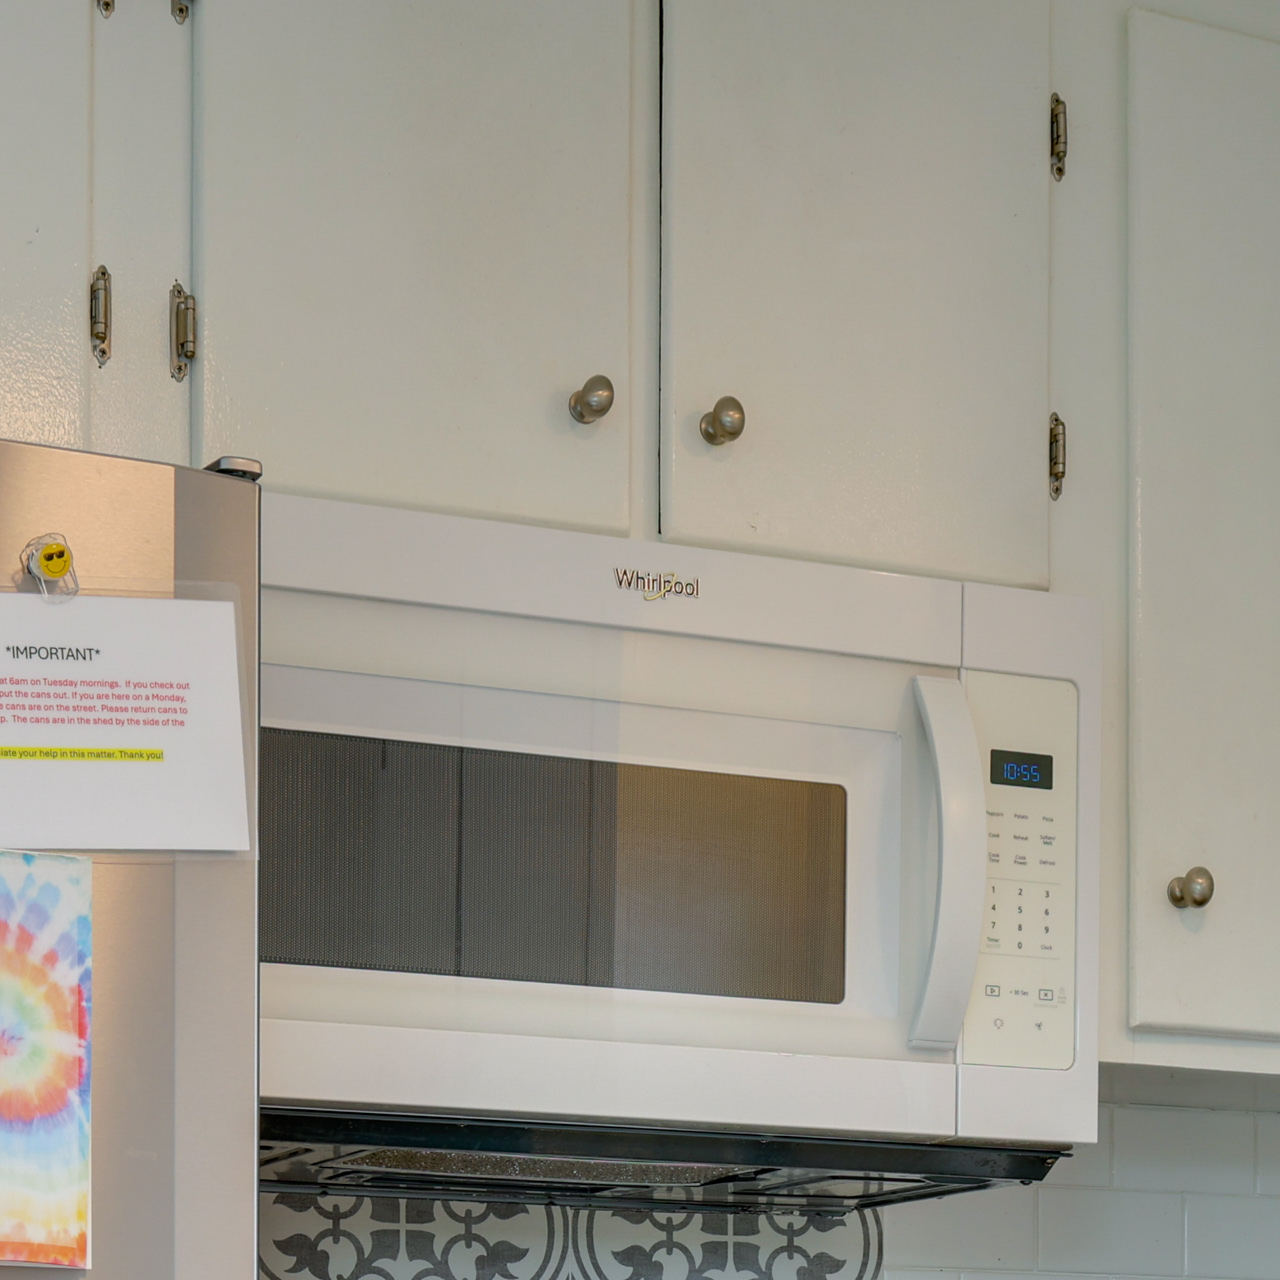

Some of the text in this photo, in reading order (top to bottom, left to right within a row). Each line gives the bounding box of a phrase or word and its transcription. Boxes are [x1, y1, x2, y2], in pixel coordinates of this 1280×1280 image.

[614, 568, 700, 599] Whirlpool
[9, 677, 28, 685] 6am
[42, 678, 78, 688] Tuesday
[80, 680, 122, 690] mornings.
[132, 682, 148, 690] you
[150, 681, 175, 689] check
[14, 690, 29, 698] the
[79, 693, 94, 701] you
[112, 693, 130, 701] here
[152, 693, 186, 704] Monday,
[56, 704, 70, 712] the
[101, 704, 129, 713] Please
[12, 715, 28, 723] The
[68, 716, 75, 724] in
[77, 717, 91, 725] the
[93, 717, 114, 725] shed
[115, 718, 125, 727] by
[126, 718, 140, 726] the
[142, 718, 160, 726] side
[171, 719, 185, 727] the
[18, 751, 38, 759] your
[39, 750, 58, 759] help
[60, 749, 68, 758] in
[70, 750, 86, 758] this
[118, 750, 144, 759] Thank
[146, 752, 164, 761] you!
[1003, 763, 1040, 782] 10:55
